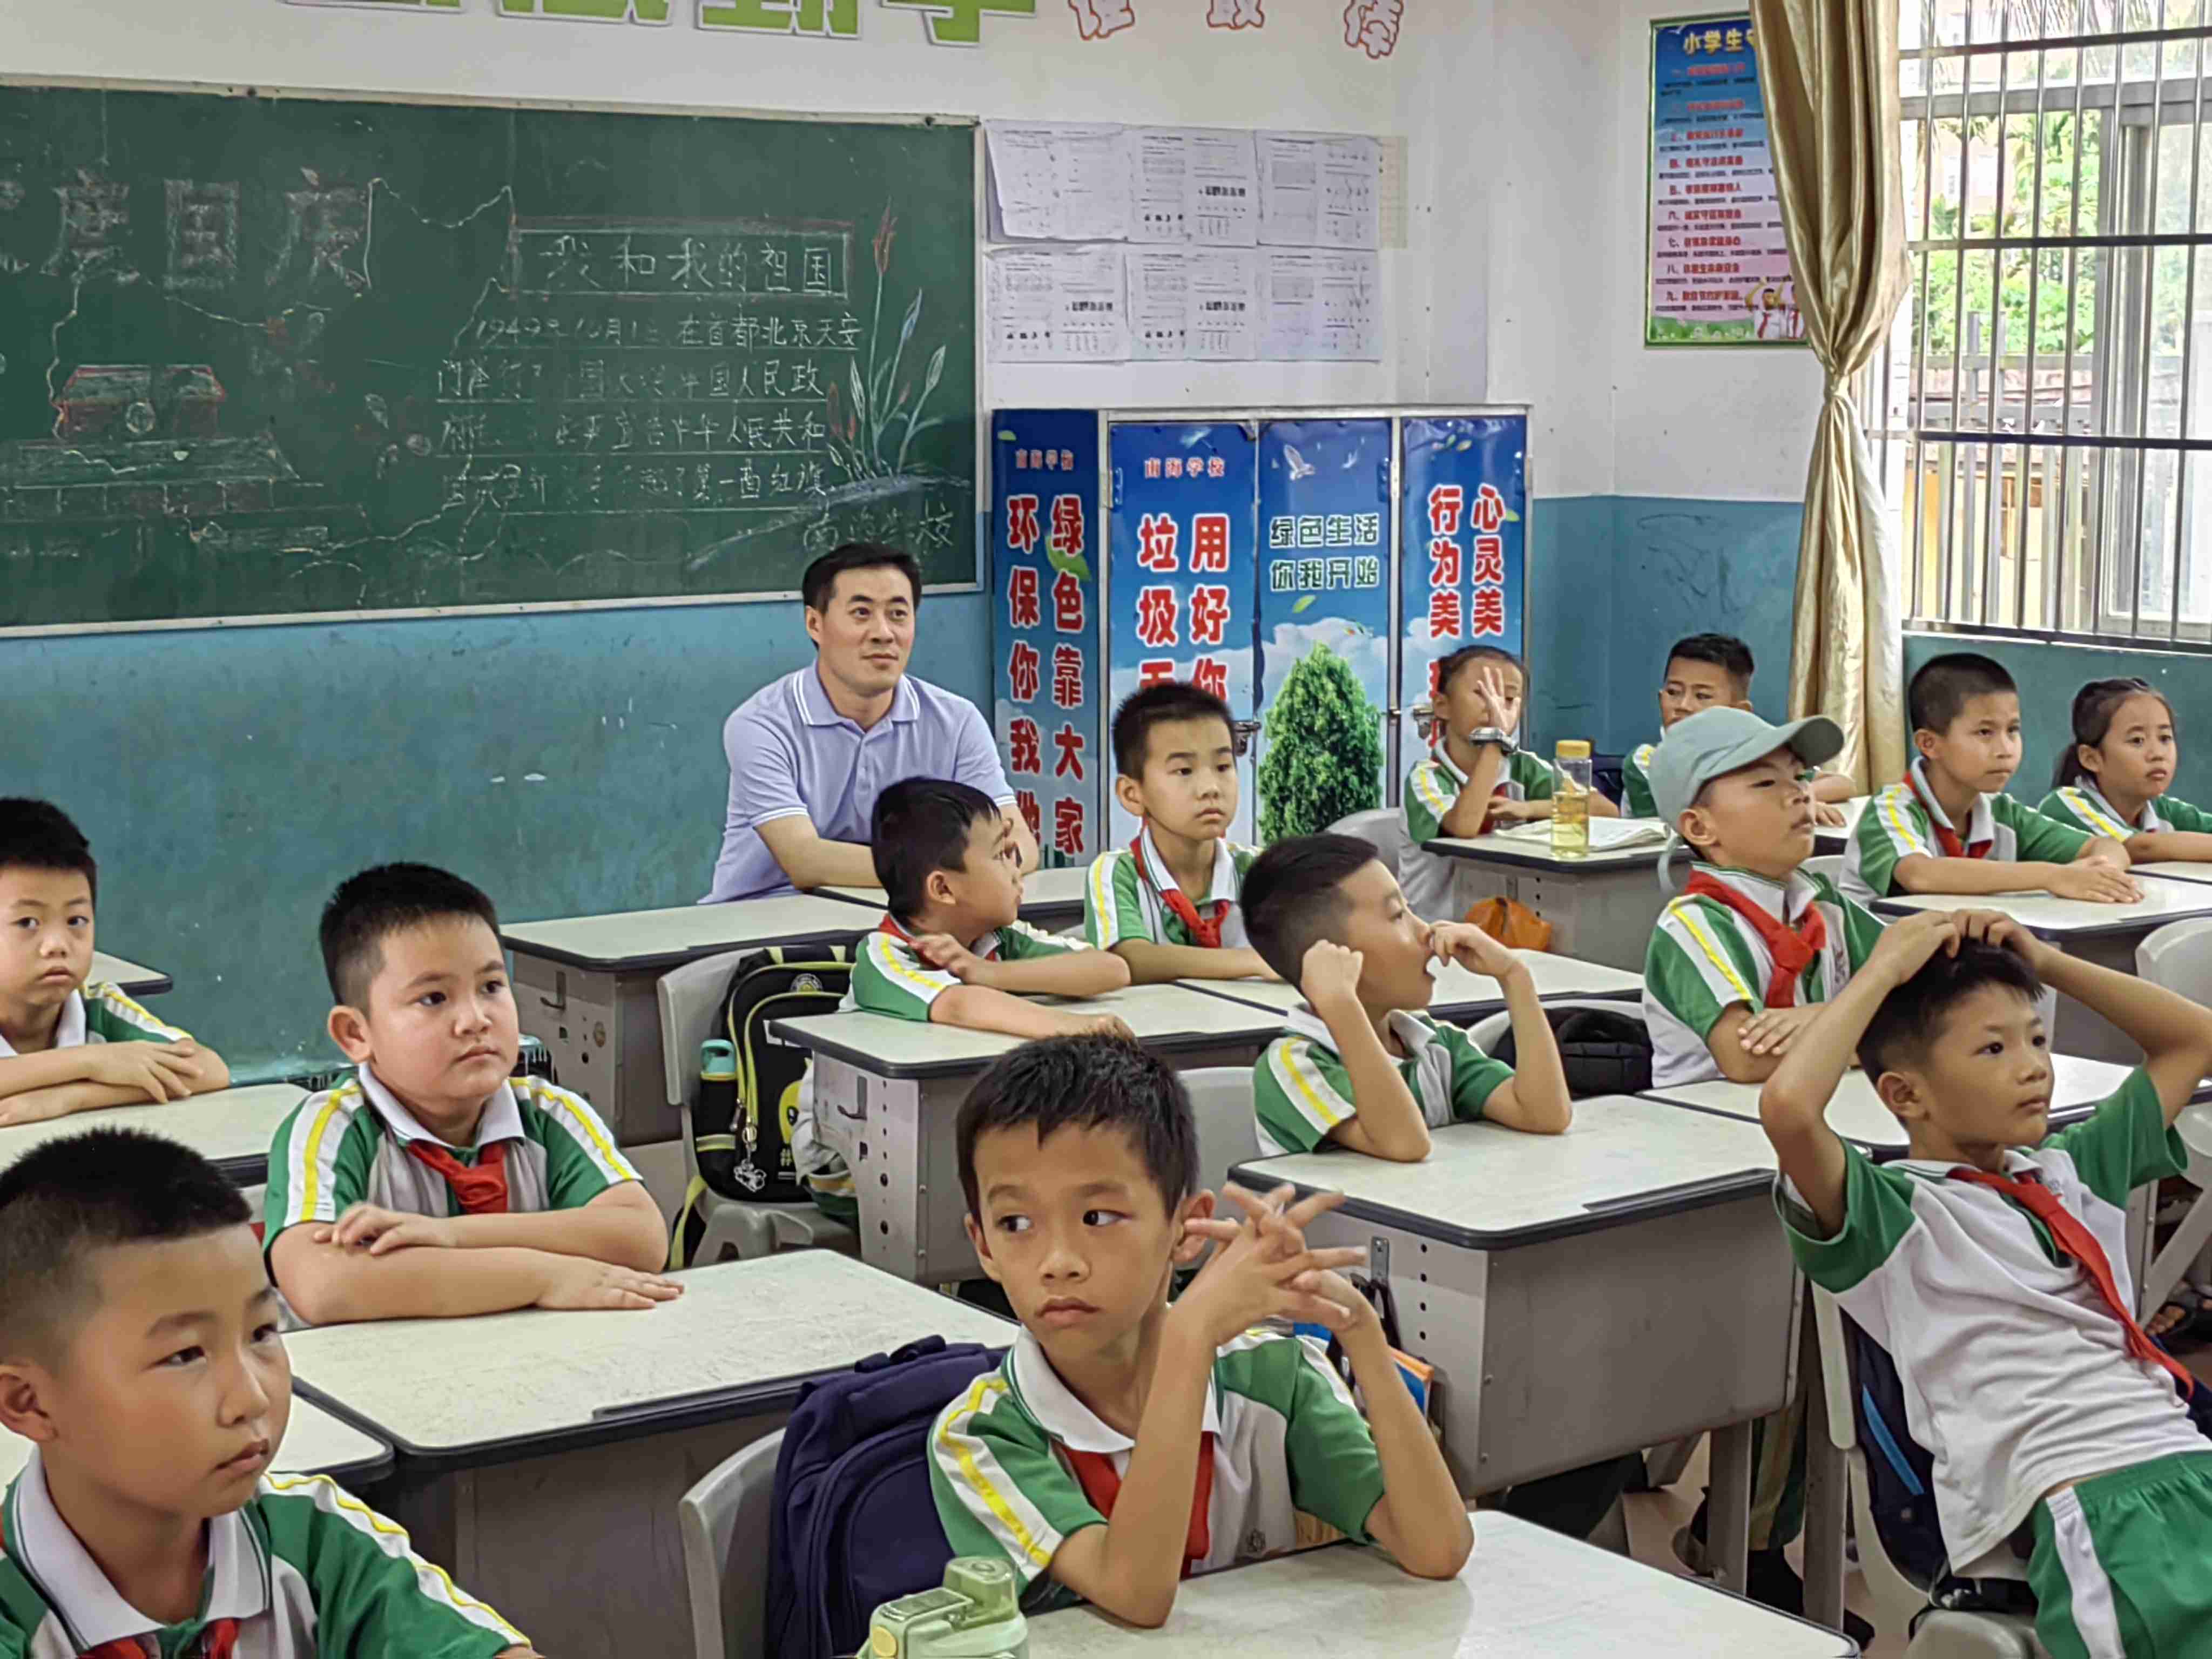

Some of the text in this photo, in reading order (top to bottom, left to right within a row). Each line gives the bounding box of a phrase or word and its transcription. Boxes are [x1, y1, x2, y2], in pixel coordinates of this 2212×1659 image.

[1270, 512, 1379, 549] 绿色生活
[1270, 555, 1380, 591] 你我开始
[1470, 482, 1507, 638] 心灵美
[1050, 494, 1084, 856] 绿色靠大家
